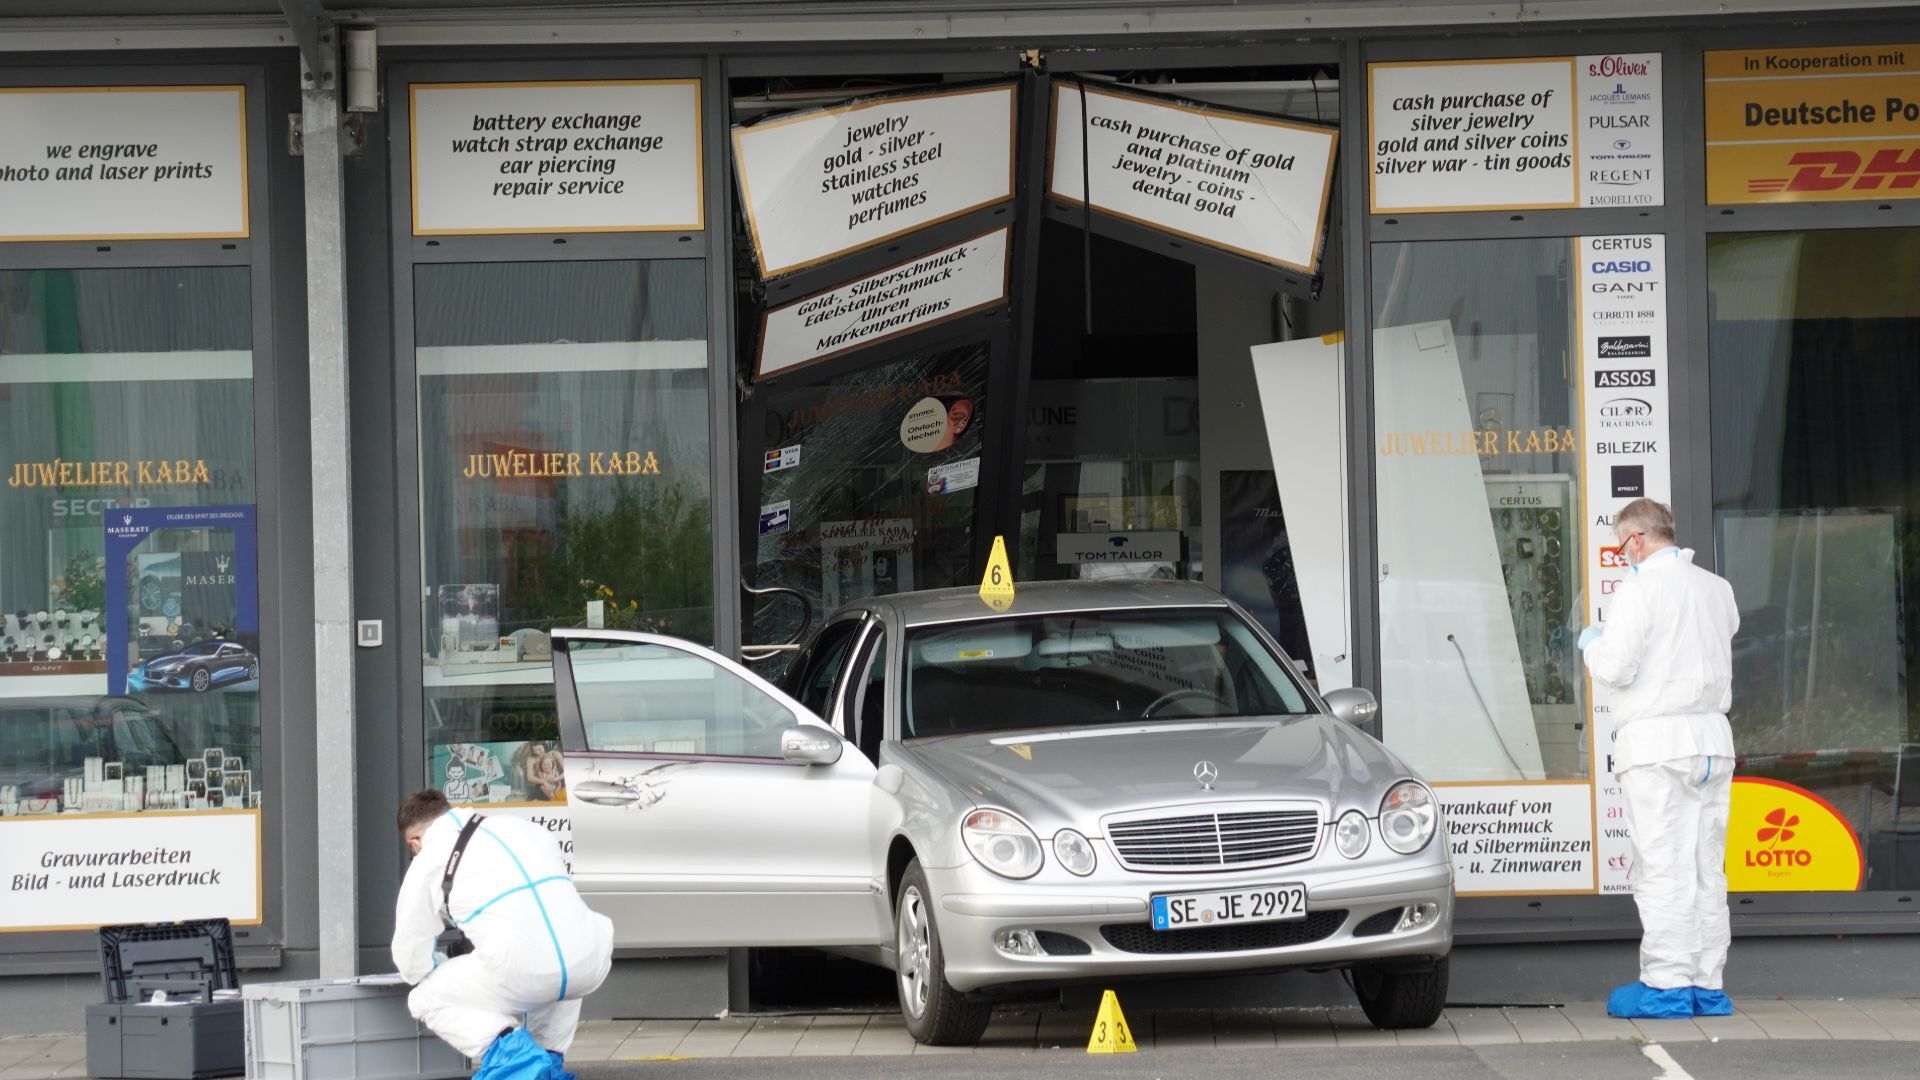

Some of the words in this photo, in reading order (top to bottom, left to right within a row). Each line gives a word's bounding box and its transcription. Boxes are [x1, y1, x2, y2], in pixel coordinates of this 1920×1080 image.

[1589, 56, 1648, 77] s.Oliver
[1744, 57, 1760, 71] In
[1766, 53, 1872, 72] Kooperation
[1878, 51, 1905, 66] mit
[1392, 94, 1435, 111] cash
[1440, 91, 1525, 112] purchase
[1531, 89, 1555, 109] of
[1622, 92, 1651, 101] LEMANS
[472, 114, 547, 133] battery
[552, 113, 642, 131] exchange
[1411, 115, 1462, 131] silver
[1463, 112, 1535, 133] jewelry
[1589, 115, 1650, 129] PULSAR
[1745, 100, 1876, 127] Deutsche
[1886, 98, 1920, 122] Po
[843, 115, 909, 148] jewelry
[46, 144, 73, 159] we
[78, 142, 159, 161] engrave
[452, 135, 510, 153] watch
[515, 136, 568, 154] strap
[573, 134, 663, 153] exchange
[823, 147, 863, 174] gold
[879, 129, 925, 156] silver
[1090, 114, 1133, 135] cash
[1137, 127, 1221, 158] purchase
[1225, 148, 1251, 165] of
[1251, 151, 1296, 171] gold
[1377, 137, 1418, 156] gold
[1423, 134, 1459, 152] and
[1465, 133, 1517, 151] silver
[1520, 131, 1569, 149] coins
[55, 164, 94, 181] and
[99, 163, 149, 181] laser
[153, 161, 213, 182] prints
[500, 159, 533, 174] ear
[537, 155, 616, 176] piercing
[821, 159, 898, 193] stainless
[902, 142, 943, 170] steel
[1126, 141, 1163, 161] and
[1166, 152, 1251, 185] platinum
[1375, 158, 1426, 175] silver
[1431, 157, 1467, 173] war
[1483, 154, 1511, 171] tin
[1516, 153, 1572, 173] goods
[1112, 155, 1182, 185] jewelry
[1197, 180, 1245, 202] coins
[1589, 169, 1652, 182] REGENT
[493, 179, 553, 198] repair
[557, 177, 624, 195] service
[851, 173, 919, 206] watches
[1132, 179, 1192, 206] dental
[1195, 198, 1236, 219] gold
[848, 190, 927, 230] perfumes
[1592, 237, 1652, 250] CERTUS
[1592, 260, 1651, 273] CASIO
[797, 293, 843, 317] Gold-,
[847, 247, 968, 299] Silberschmuck
[1592, 281, 1659, 293] GANT
[804, 268, 952, 328] Edelstahlschmuck
[860, 298, 910, 323] Uhren
[1593, 310, 1634, 320] CERRUTI
[815, 297, 951, 352] Markenparfüms
[1598, 371, 1652, 387] ASSOS
[907, 420, 944, 434] Ohrloch-
[1600, 420, 1653, 428] TRAURINGE
[907, 429, 940, 443] stechen
[1380, 428, 1500, 457] JUWELIER
[1507, 429, 1577, 454] KABA
[1597, 441, 1657, 454] BILEZIK
[8, 457, 131, 487] JUWELIER
[138, 459, 211, 486] KABA
[463, 449, 583, 478] JUWELIER
[588, 450, 661, 476] KABA
[1499, 496, 1542, 505] CERTUS
[107, 526, 149, 534] MASERATI
[1074, 552, 1107, 561] TOM
[1110, 550, 1163, 560] TAILOR
[186, 575, 236, 585] MASER
[991, 564, 1002, 586] 6
[1522, 801, 1552, 814] von
[1474, 839, 1591, 855] Silbermünzen
[40, 847, 192, 869] Gravurarbeiten
[1470, 862, 1484, 874] u.
[1490, 858, 1582, 874] Zinnwaren
[1745, 850, 1812, 867] LOTTO
[11, 874, 49, 891] Bild
[68, 872, 105, 890] und
[111, 868, 222, 888] Laserdruck
[1158, 917, 1164, 925] D
[1170, 898, 1199, 924] SE
[1217, 895, 1245, 920] JE
[1250, 889, 1304, 917] 2992
[1097, 1021, 1107, 1043] 3
[1117, 1021, 1126, 1043] 3
